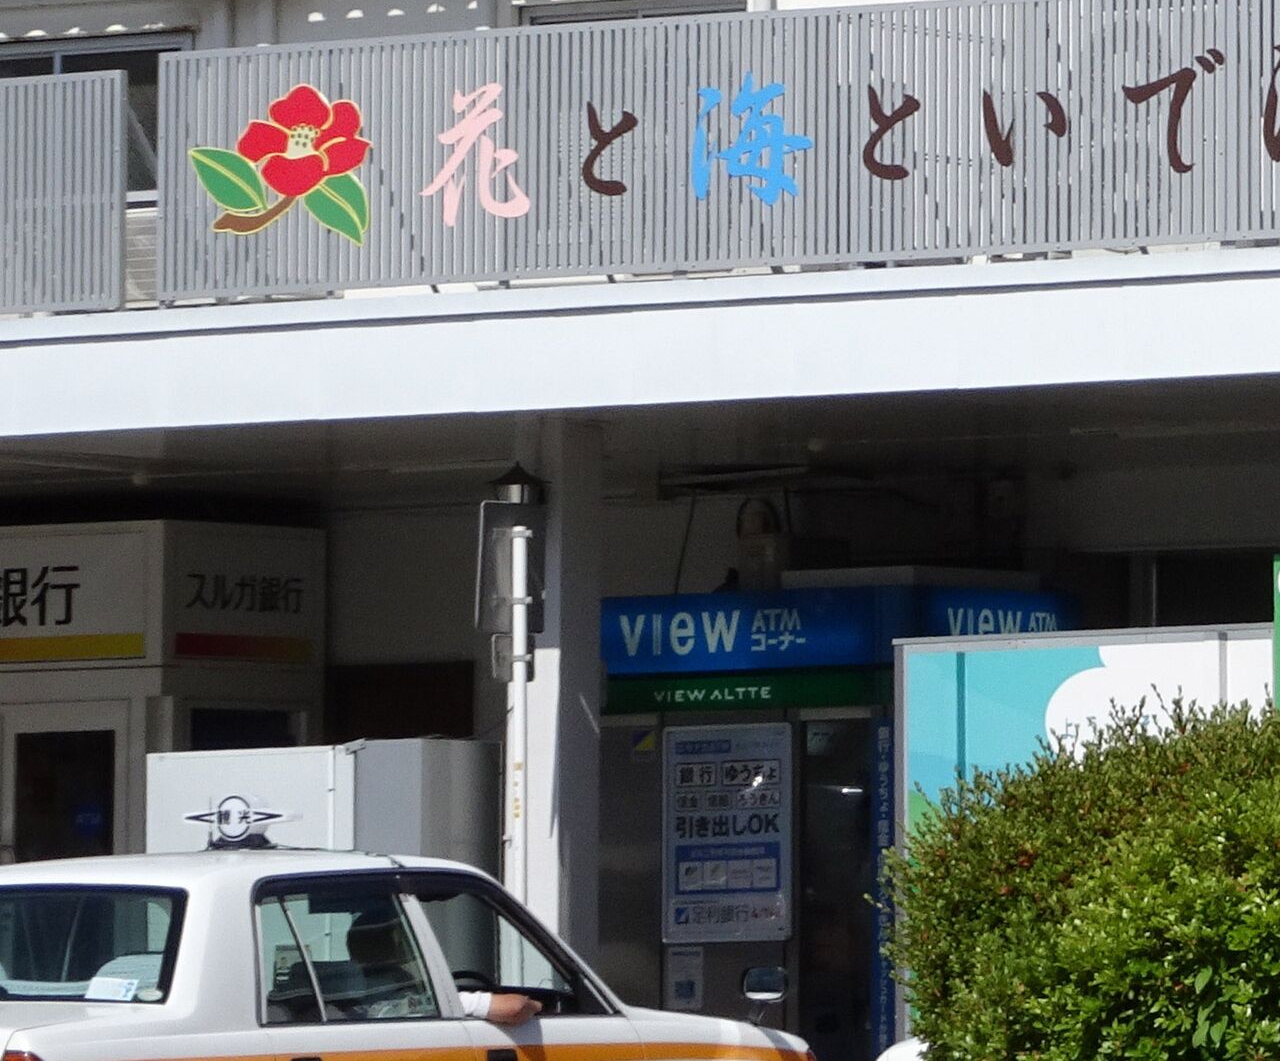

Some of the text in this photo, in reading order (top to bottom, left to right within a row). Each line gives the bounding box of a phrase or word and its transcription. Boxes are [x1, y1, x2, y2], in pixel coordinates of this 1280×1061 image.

[184, 573, 305, 613] スルガ銀行
[750, 607, 801, 633] ATM
[750, 631, 806, 651] コーナー
[675, 814, 780, 838] 引き出しOK
